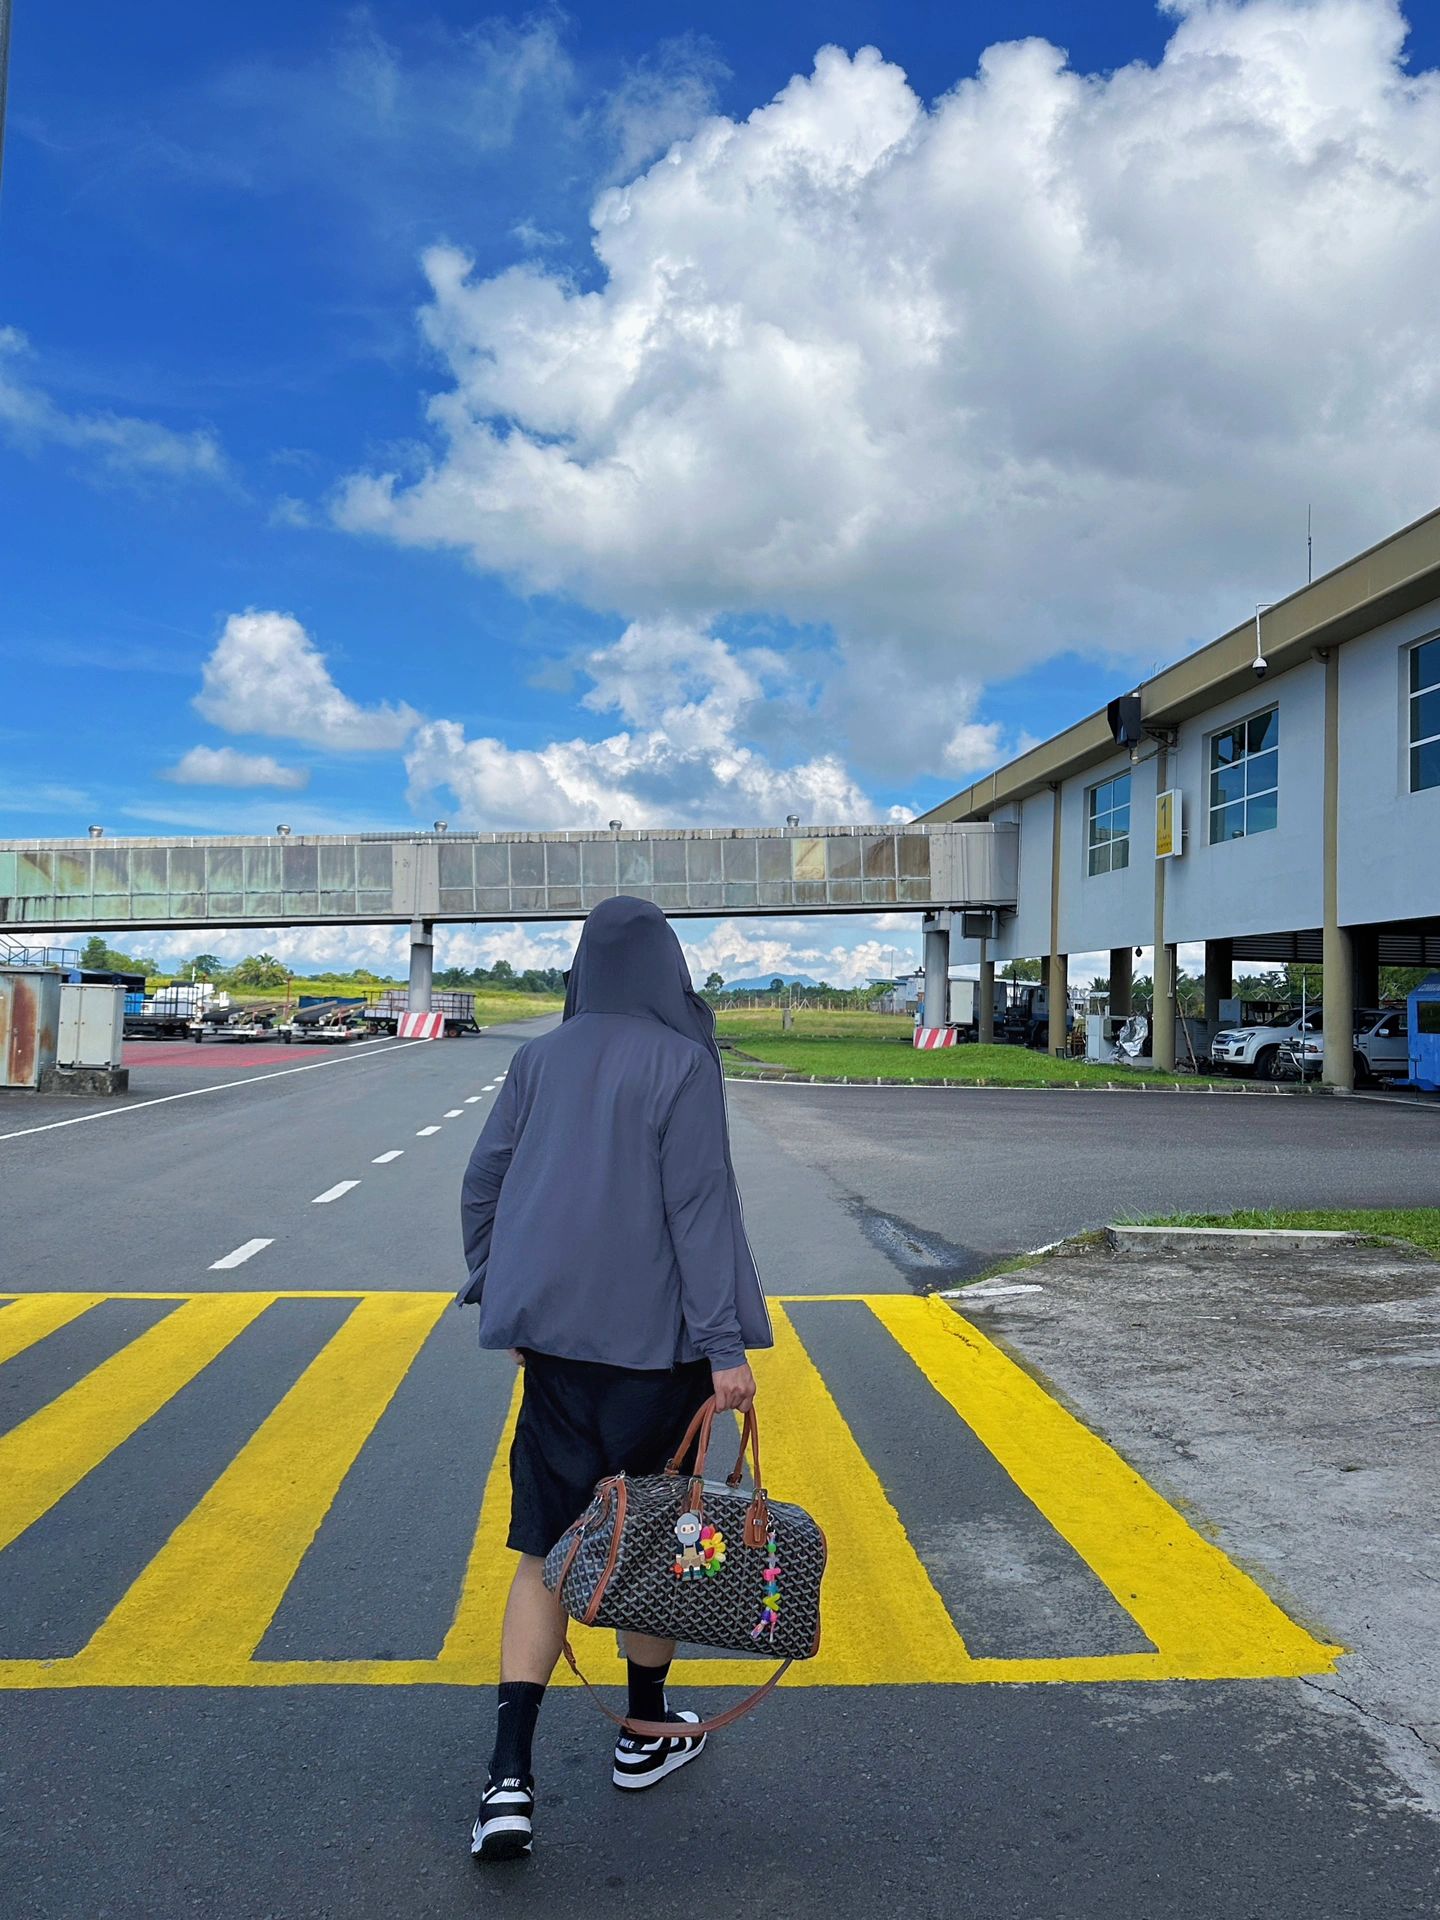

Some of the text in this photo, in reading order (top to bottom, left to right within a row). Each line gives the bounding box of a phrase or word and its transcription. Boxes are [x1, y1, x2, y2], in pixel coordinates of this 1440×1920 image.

[1161, 798, 1167, 829] 1
[619, 1737, 635, 1749] NIKE
[502, 1777, 521, 1788] NIKE
